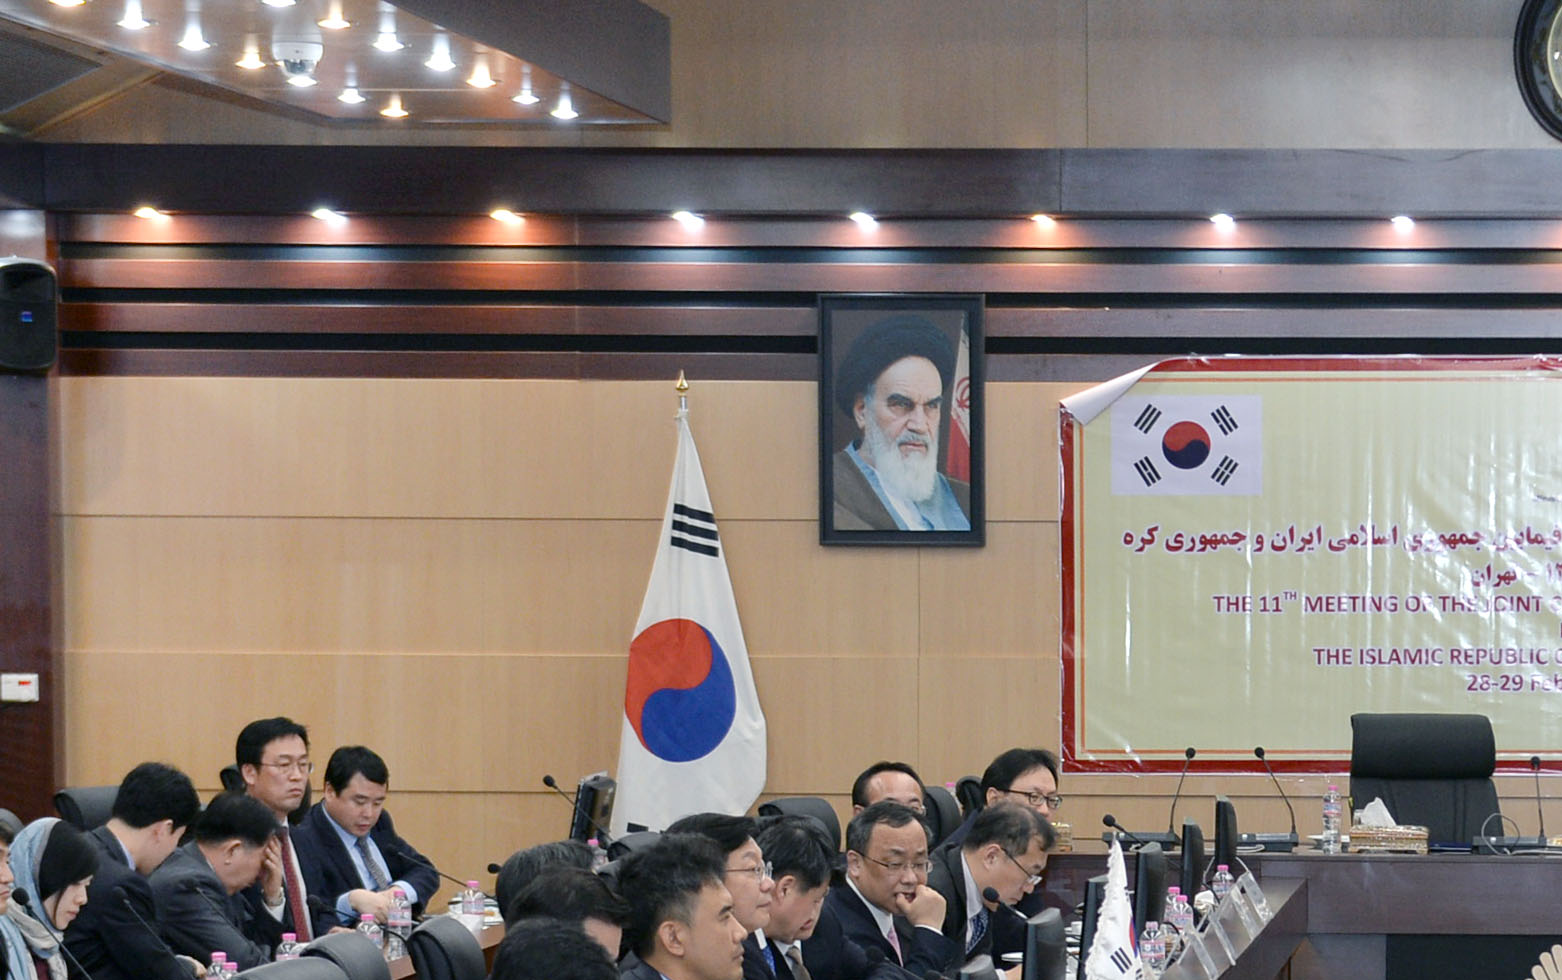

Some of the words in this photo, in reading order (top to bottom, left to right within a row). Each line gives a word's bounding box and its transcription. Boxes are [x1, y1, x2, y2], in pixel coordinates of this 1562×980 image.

[1122, 525, 1159, 551] کره
[1164, 525, 1247, 551] جمهوری
[1253, 535, 1265, 551] و
[1270, 525, 1322, 551] ایران
[1327, 525, 1397, 551] اسلامی
[1213, 595, 1252, 613] THE
[1304, 595, 1398, 613] MEETING
[1405, 595, 1433, 613] OF
[1439, 595, 1478, 613] THE
[1313, 648, 1353, 666] THE
[1358, 648, 1444, 666] ISLAMIC
[1450, 648, 1549, 666] REPUBLIC
[1466, 674, 1524, 692] 28-29
